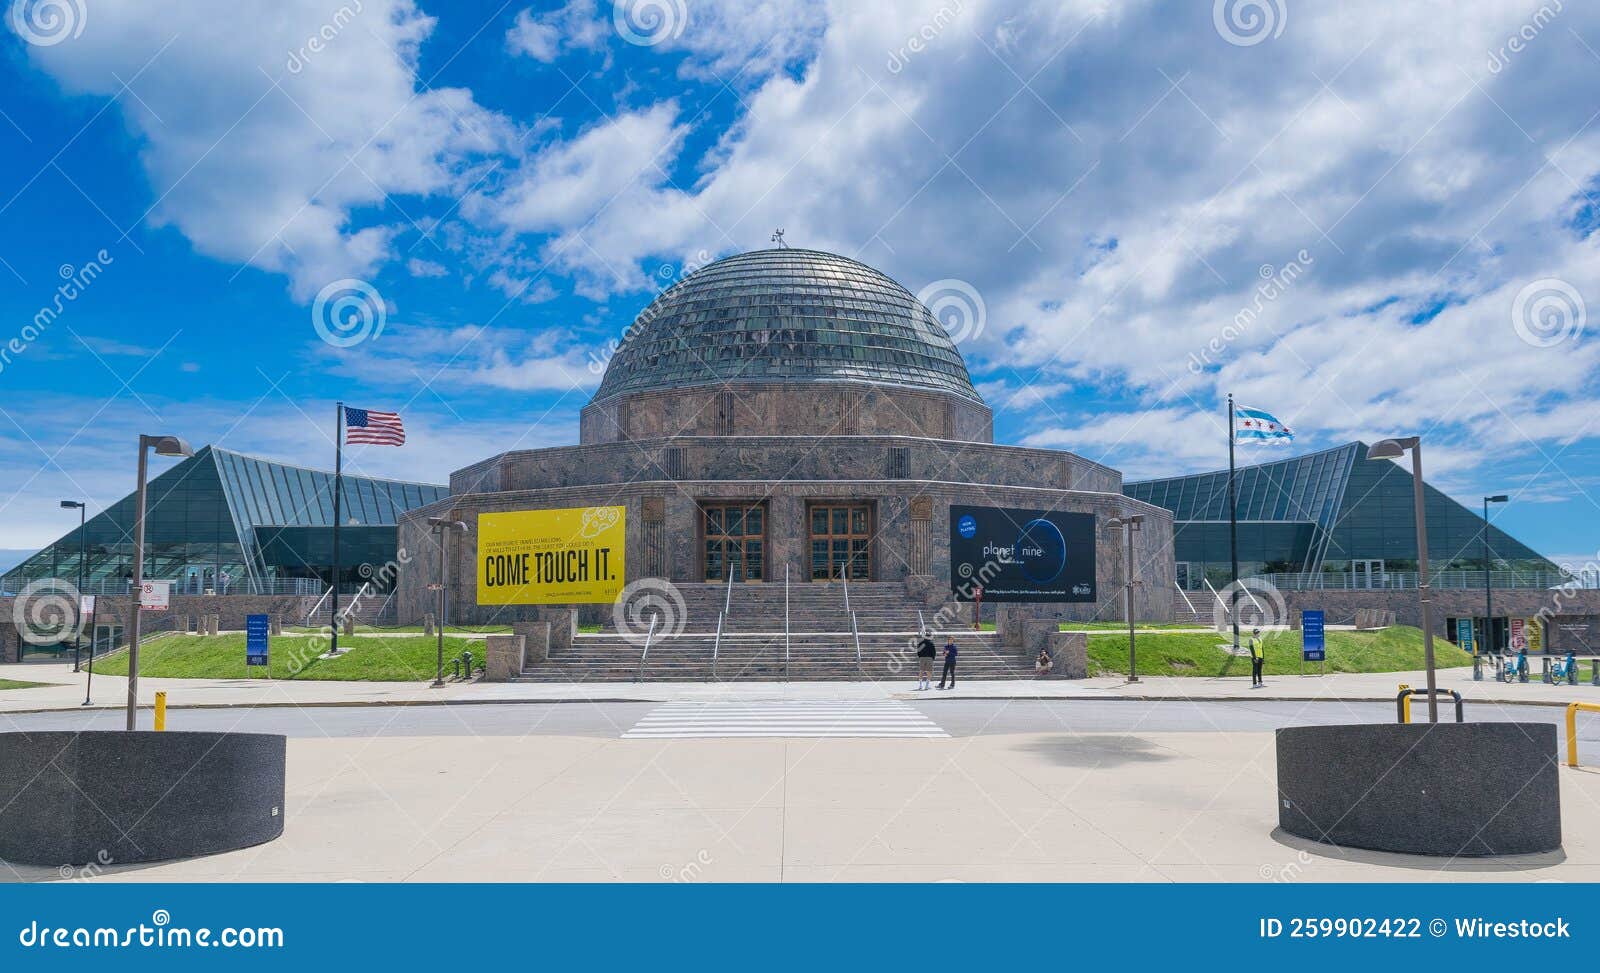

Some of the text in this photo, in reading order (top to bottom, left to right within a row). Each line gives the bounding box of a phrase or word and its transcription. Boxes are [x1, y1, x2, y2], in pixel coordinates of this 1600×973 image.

[983, 540, 1042, 558] planet nine
[486, 548, 615, 587] COME TOUCH IT.
